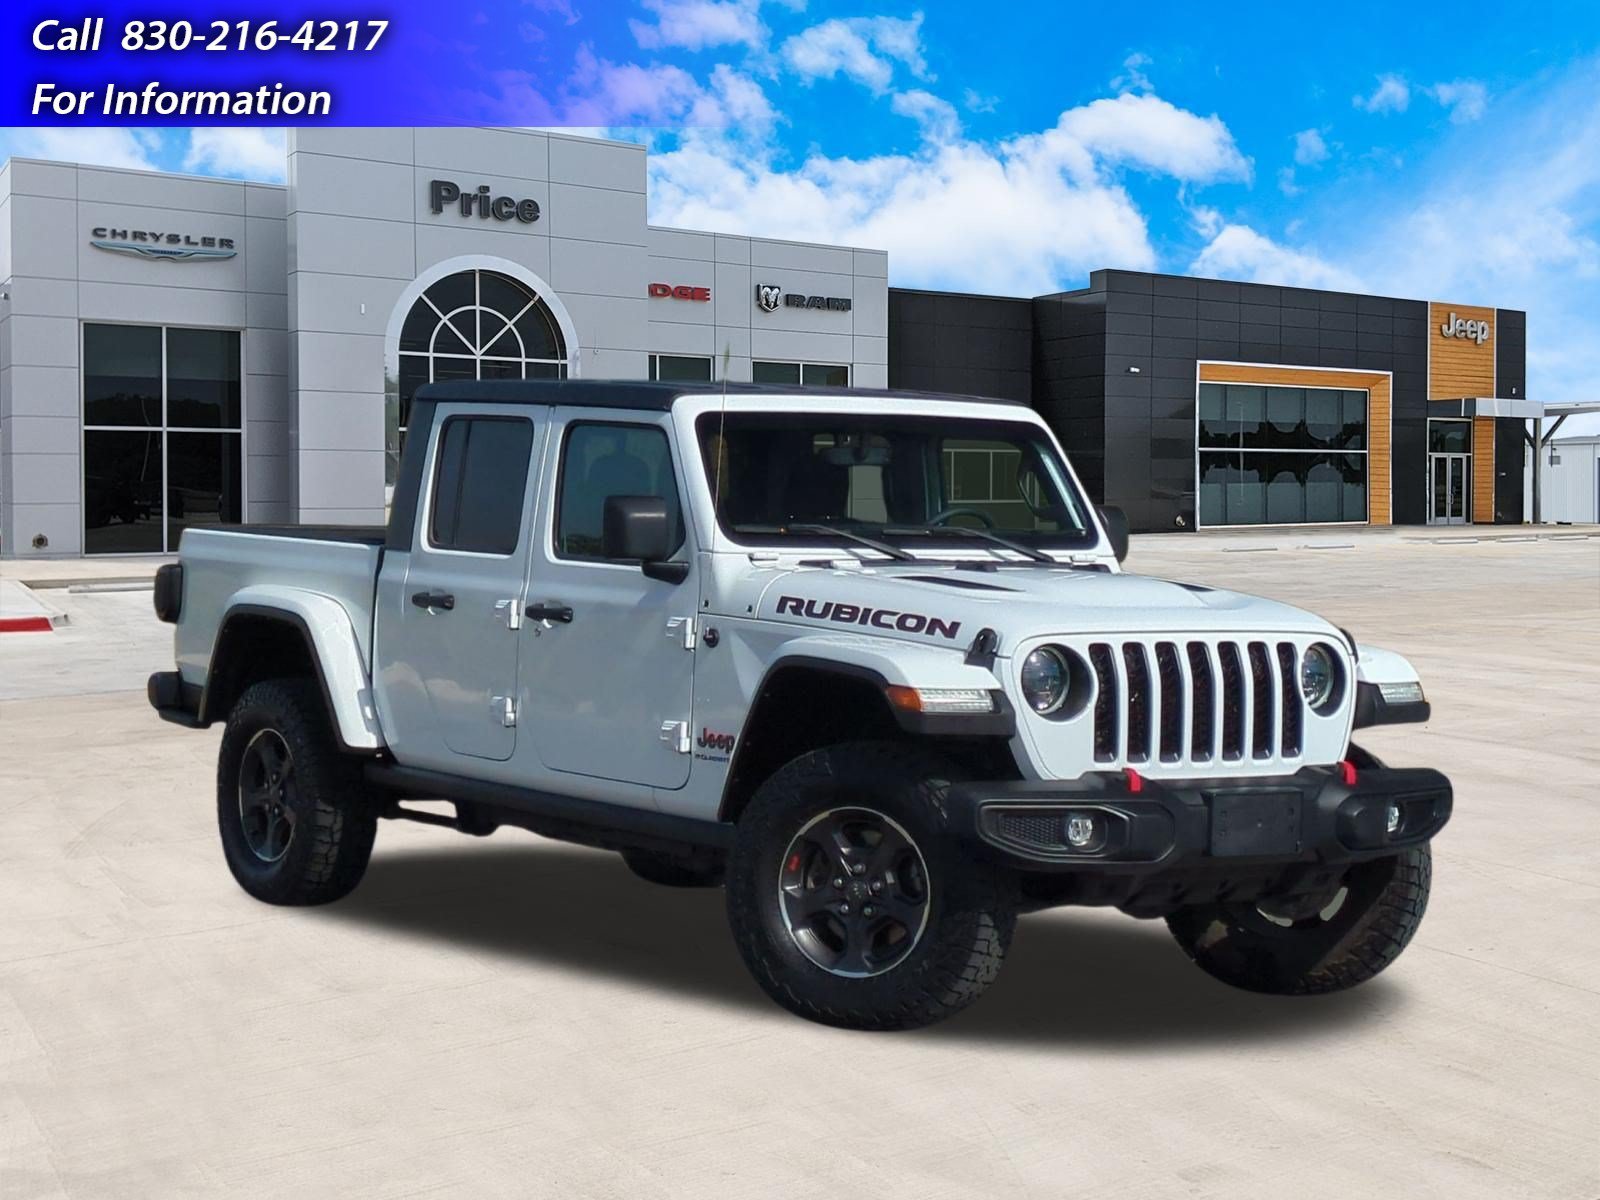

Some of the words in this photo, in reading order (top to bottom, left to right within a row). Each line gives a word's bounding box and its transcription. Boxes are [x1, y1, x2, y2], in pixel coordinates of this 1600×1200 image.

[430, 179, 541, 224] Price
[91, 227, 235, 249] CHRYSLER
[786, 294, 852, 312] RAM
[1441, 312, 1490, 345] Jeep
[776, 595, 962, 640] RUBICON
[697, 727, 735, 754] Jeep
